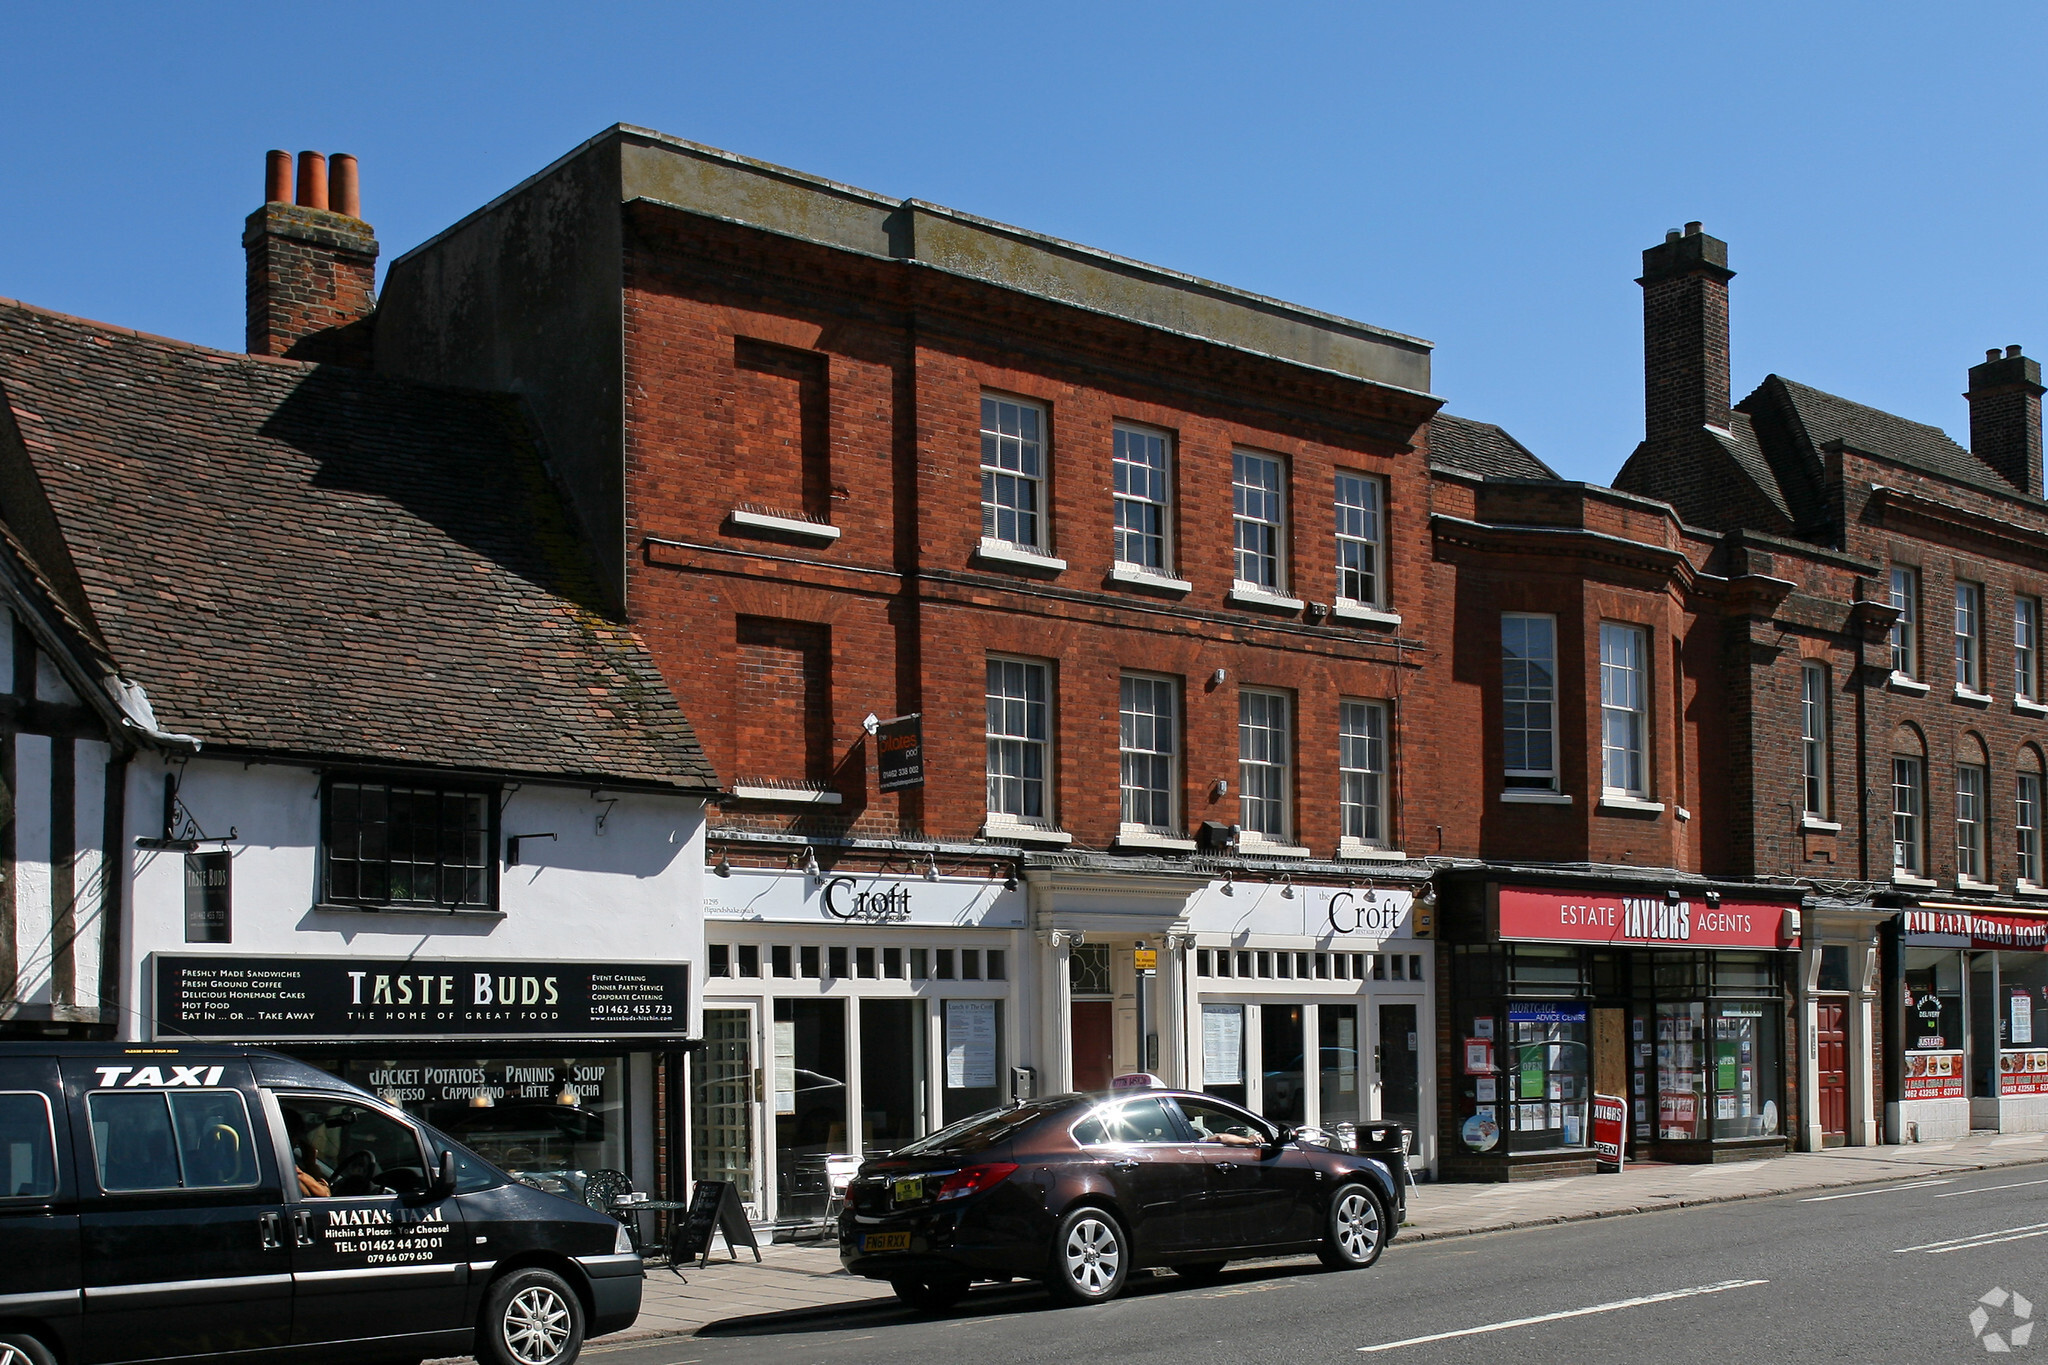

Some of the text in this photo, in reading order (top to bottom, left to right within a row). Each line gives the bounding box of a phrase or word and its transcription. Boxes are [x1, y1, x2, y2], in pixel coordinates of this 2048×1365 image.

[187, 869, 226, 887] TASTE BUDS
[814, 876, 828, 885] the
[825, 876, 912, 919] Croft
[1319, 891, 1330, 900] the
[1328, 892, 1400, 934] Croft
[1560, 898, 1751, 940] ESTATE TAYLORS AGENTS
[1973, 917, 2012, 945] KEBAB
[182, 969, 301, 978] FRESHLY MADE SANDWICHES
[182, 980, 282, 988] FRESH GROUND COFFEE
[347, 971, 559, 1005] TASTE BUDS
[229, 991, 277, 999] HOMEMADE
[279, 991, 306, 999] CAKES
[590, 1005, 673, 1014] t:01462 455 733
[1510, 1002, 1557, 1013] MORTGAGE
[182, 1012, 200, 1020] EAT
[204, 1012, 216, 1020] IN
[230, 1012, 244, 1020] OR
[258, 1012, 283, 1020] TAKE
[286, 1012, 315, 1020] AWAY
[347, 1012, 559, 1020] THE HOME OF GREAT FOOD
[1522, 1061, 1542, 1071] OPEN
[95, 1066, 225, 1087] TAXI
[369, 1065, 605, 1086] JACKET POTATOES PANINIS SOUP
[377, 1087, 426, 1101] ESPRESSO
[520, 1085, 549, 1098] LATTE
[564, 1083, 599, 1097] MOCHA
[1594, 1105, 1621, 1121] AYLORS
[328, 1206, 443, 1227] MATA's TAXI
[325, 1228, 356, 1238] Hitchin
[398, 1226, 415, 1235] You
[416, 1224, 450, 1234] Choose!
[335, 1237, 443, 1252] TEL: 01462 44 20 01
[866, 1234, 906, 1249] FN61 RXX
[367, 1251, 433, 1263] 079 66 079 650
